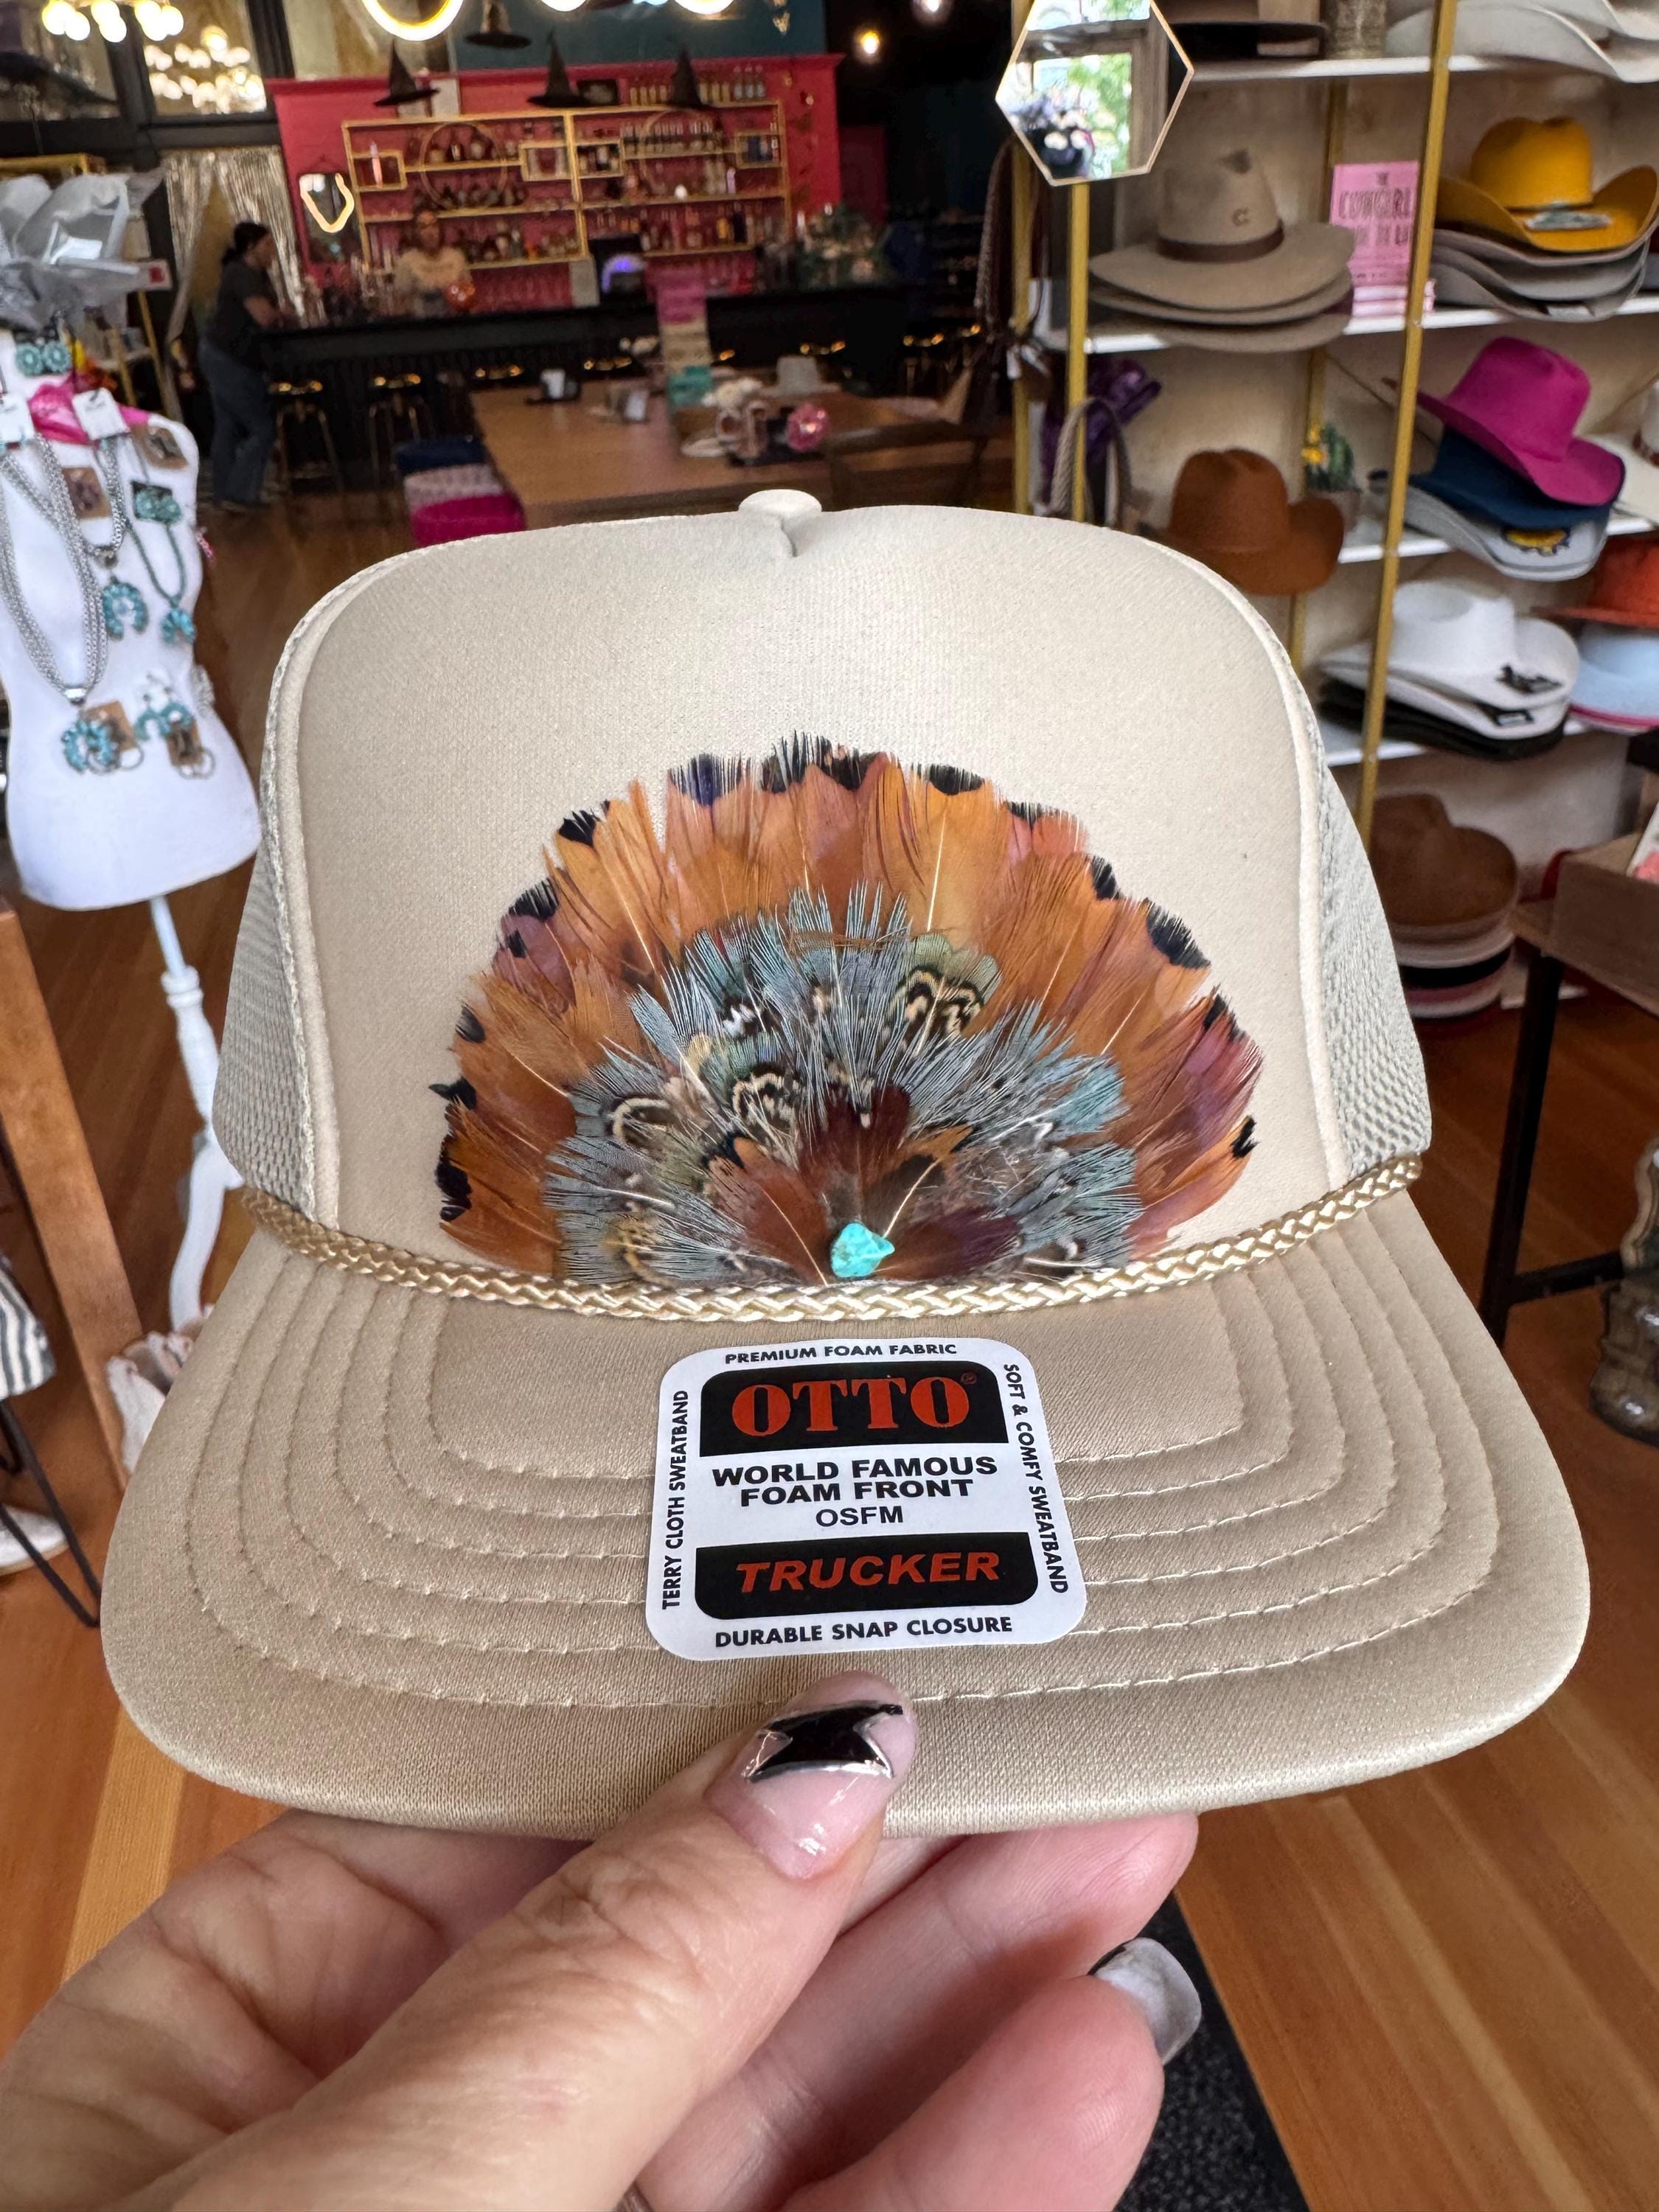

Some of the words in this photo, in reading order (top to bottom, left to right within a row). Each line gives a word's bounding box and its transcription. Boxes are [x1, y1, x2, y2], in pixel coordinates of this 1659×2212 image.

[725, 1347, 817, 1364] PREMIUM
[824, 1345, 883, 1357] FOAM
[888, 1344, 957, 1355] FABRIC
[1004, 1363, 1026, 1399] SOFT
[731, 1377, 970, 1437] OTTO
[1012, 1404, 1028, 1416] &
[669, 1390, 689, 1491] SWEATBAND
[1015, 1422, 1043, 1481] COMFY
[712, 1461, 839, 1487] WORLD
[852, 1456, 998, 1478] FAMOUS
[740, 1483, 841, 1507] FOAM
[853, 1478, 974, 1500] FRONT
[665, 1496, 685, 1549] CLOTH
[815, 1505, 903, 1527] OSFM
[1028, 1486, 1068, 1593] SWEATBAND
[661, 1555, 682, 1610] TERRY
[736, 1552, 1000, 1593] TRUCKER
[715, 1625, 823, 1648] DURABLE
[832, 1621, 898, 1641] SNAP
[906, 1616, 1012, 1636] CLOSURE
